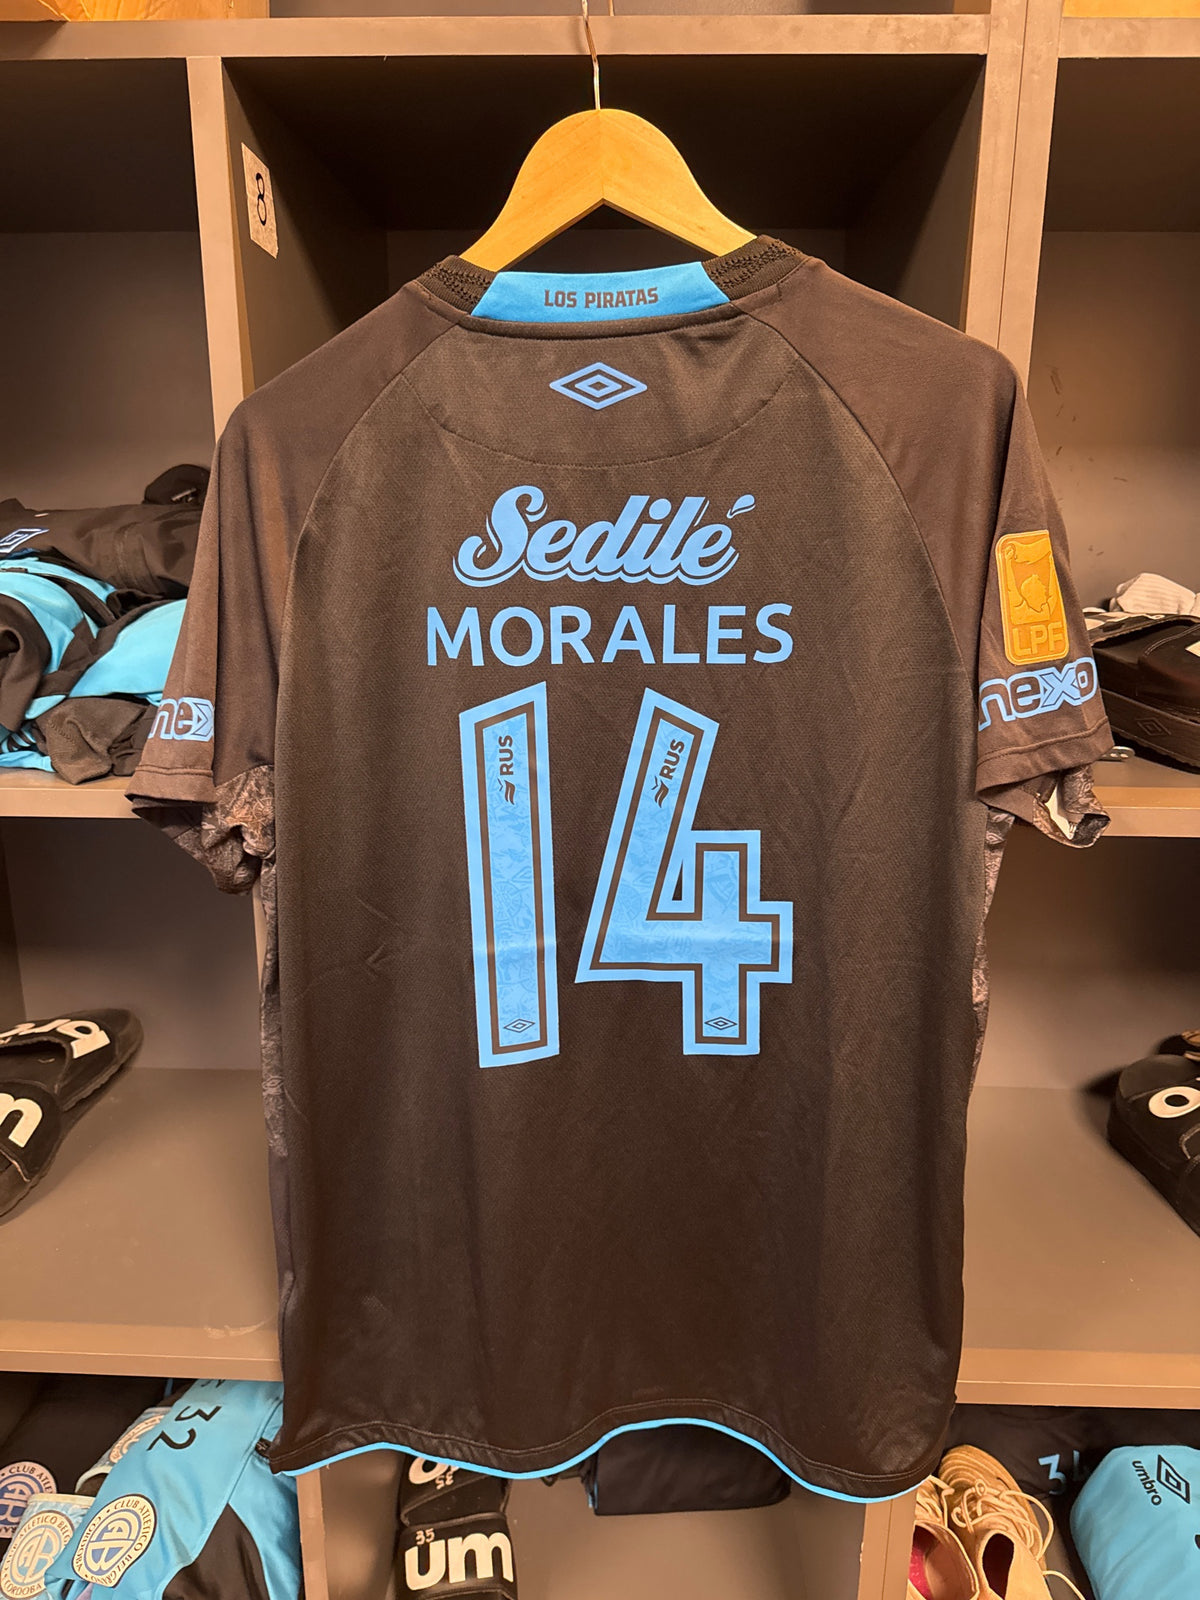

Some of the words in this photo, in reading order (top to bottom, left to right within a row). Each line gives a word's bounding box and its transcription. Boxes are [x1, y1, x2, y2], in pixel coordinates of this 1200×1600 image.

[256, 172, 267, 226] 8
[544, 289, 577, 308] LOS
[584, 287, 659, 308] PIRATAS
[453, 485, 756, 588] Sedilé
[427, 603, 793, 666] MORALES
[1012, 621, 1065, 656] LPF
[499, 734, 514, 776] RUS
[659, 739, 686, 781] RUS
[459, 681, 793, 1068] 14
[9, 1464, 36, 1475] CLUB
[36, 1472, 55, 1494] ATLE
[1131, 1460, 1162, 1506] umbro
[114, 1498, 140, 1510] CLUB
[415, 1527, 435, 1546] 35
